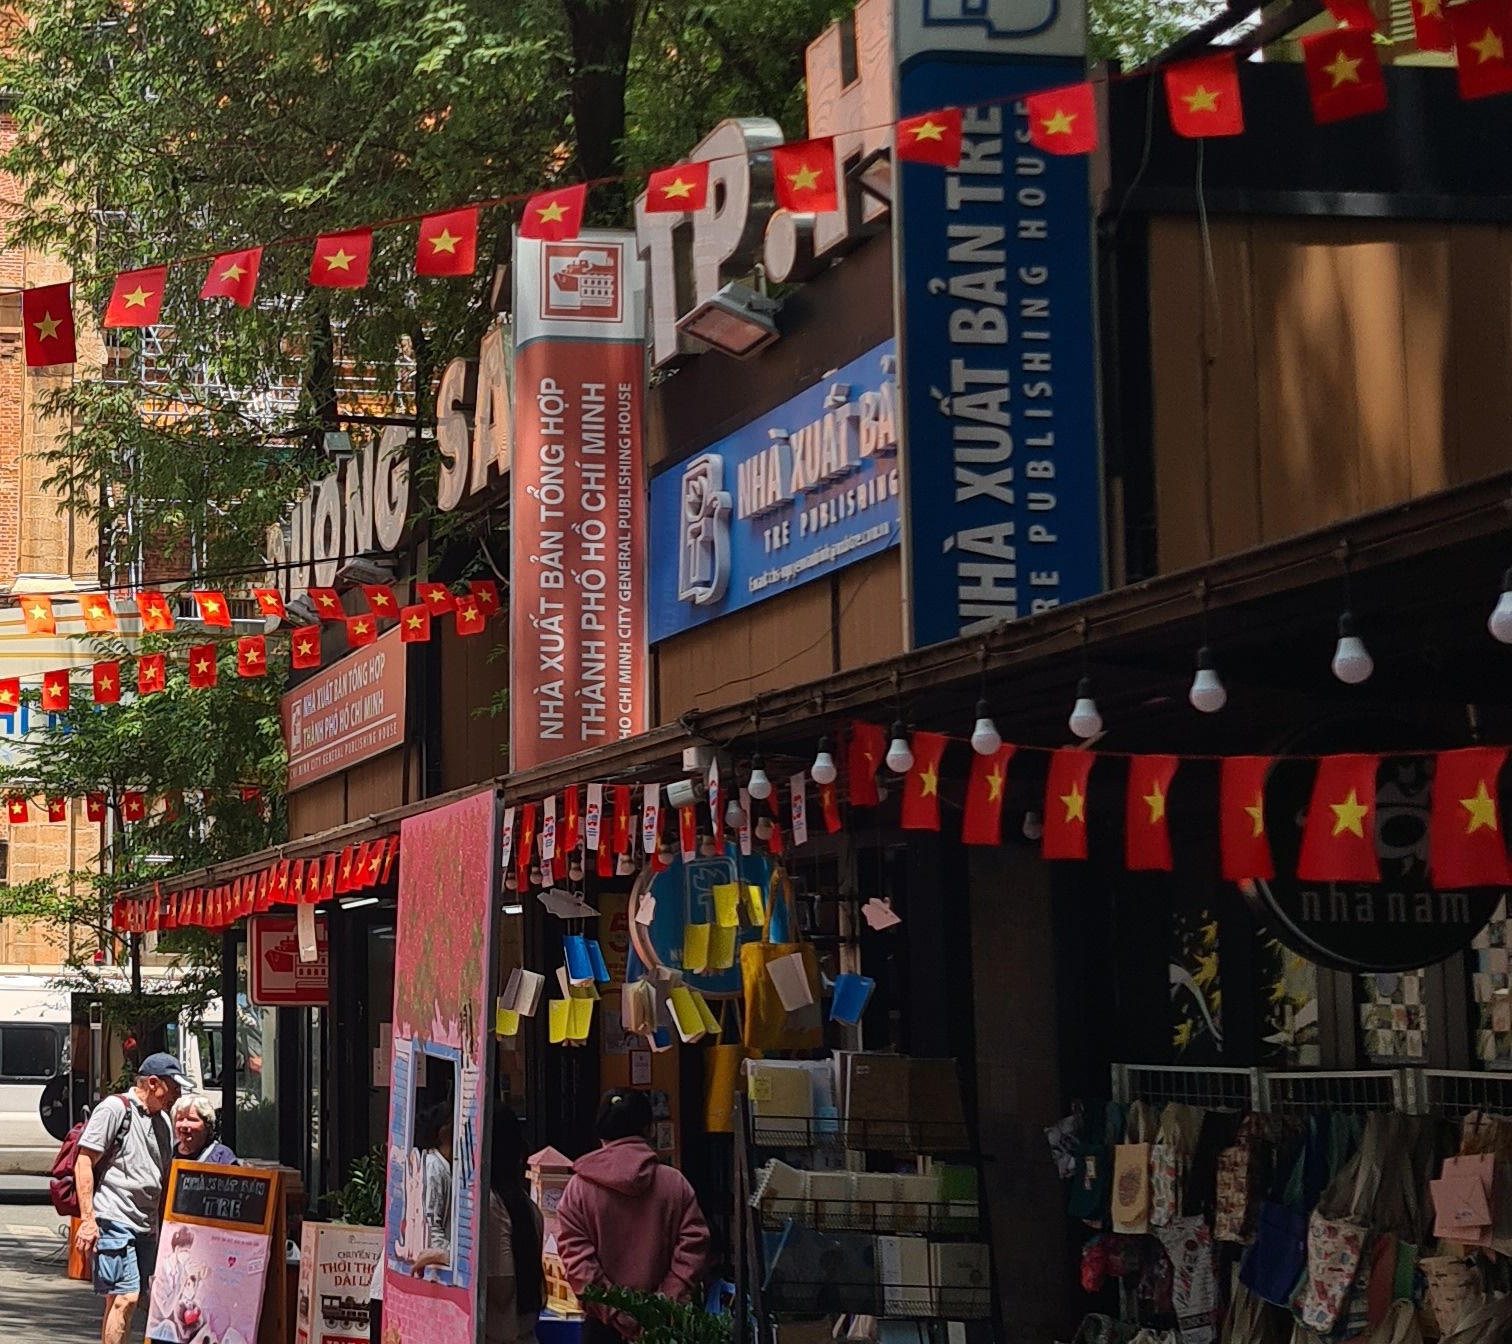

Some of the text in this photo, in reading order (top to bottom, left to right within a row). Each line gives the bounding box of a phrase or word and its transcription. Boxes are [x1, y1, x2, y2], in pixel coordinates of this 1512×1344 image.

[928, 225, 1009, 343] BẢN
[618, 383, 632, 435] HOUSE
[737, 428, 795, 519] NHÀ
[790, 369, 861, 493] XUẤT
[930, 359, 1015, 504] XUẤT
[1019, 264, 1058, 544] PUBLISHING
[618, 438, 632, 529] PUBLISHING
[764, 469, 900, 553] TRE PUBLISHING
[526, 377, 569, 739] NHÀ XUẤT BẢN TỔNG HỢP
[571, 383, 606, 741] THÀNH PHỐ HỒ CHÍ MINH
[618, 533, 632, 602] GENERAL
[943, 521, 1017, 638] NHÀ
[618, 605, 632, 639] CITY
[619, 642, 632, 684] MINH
[619, 687, 632, 713] CHI
[1387, 891, 1471, 924] nam
